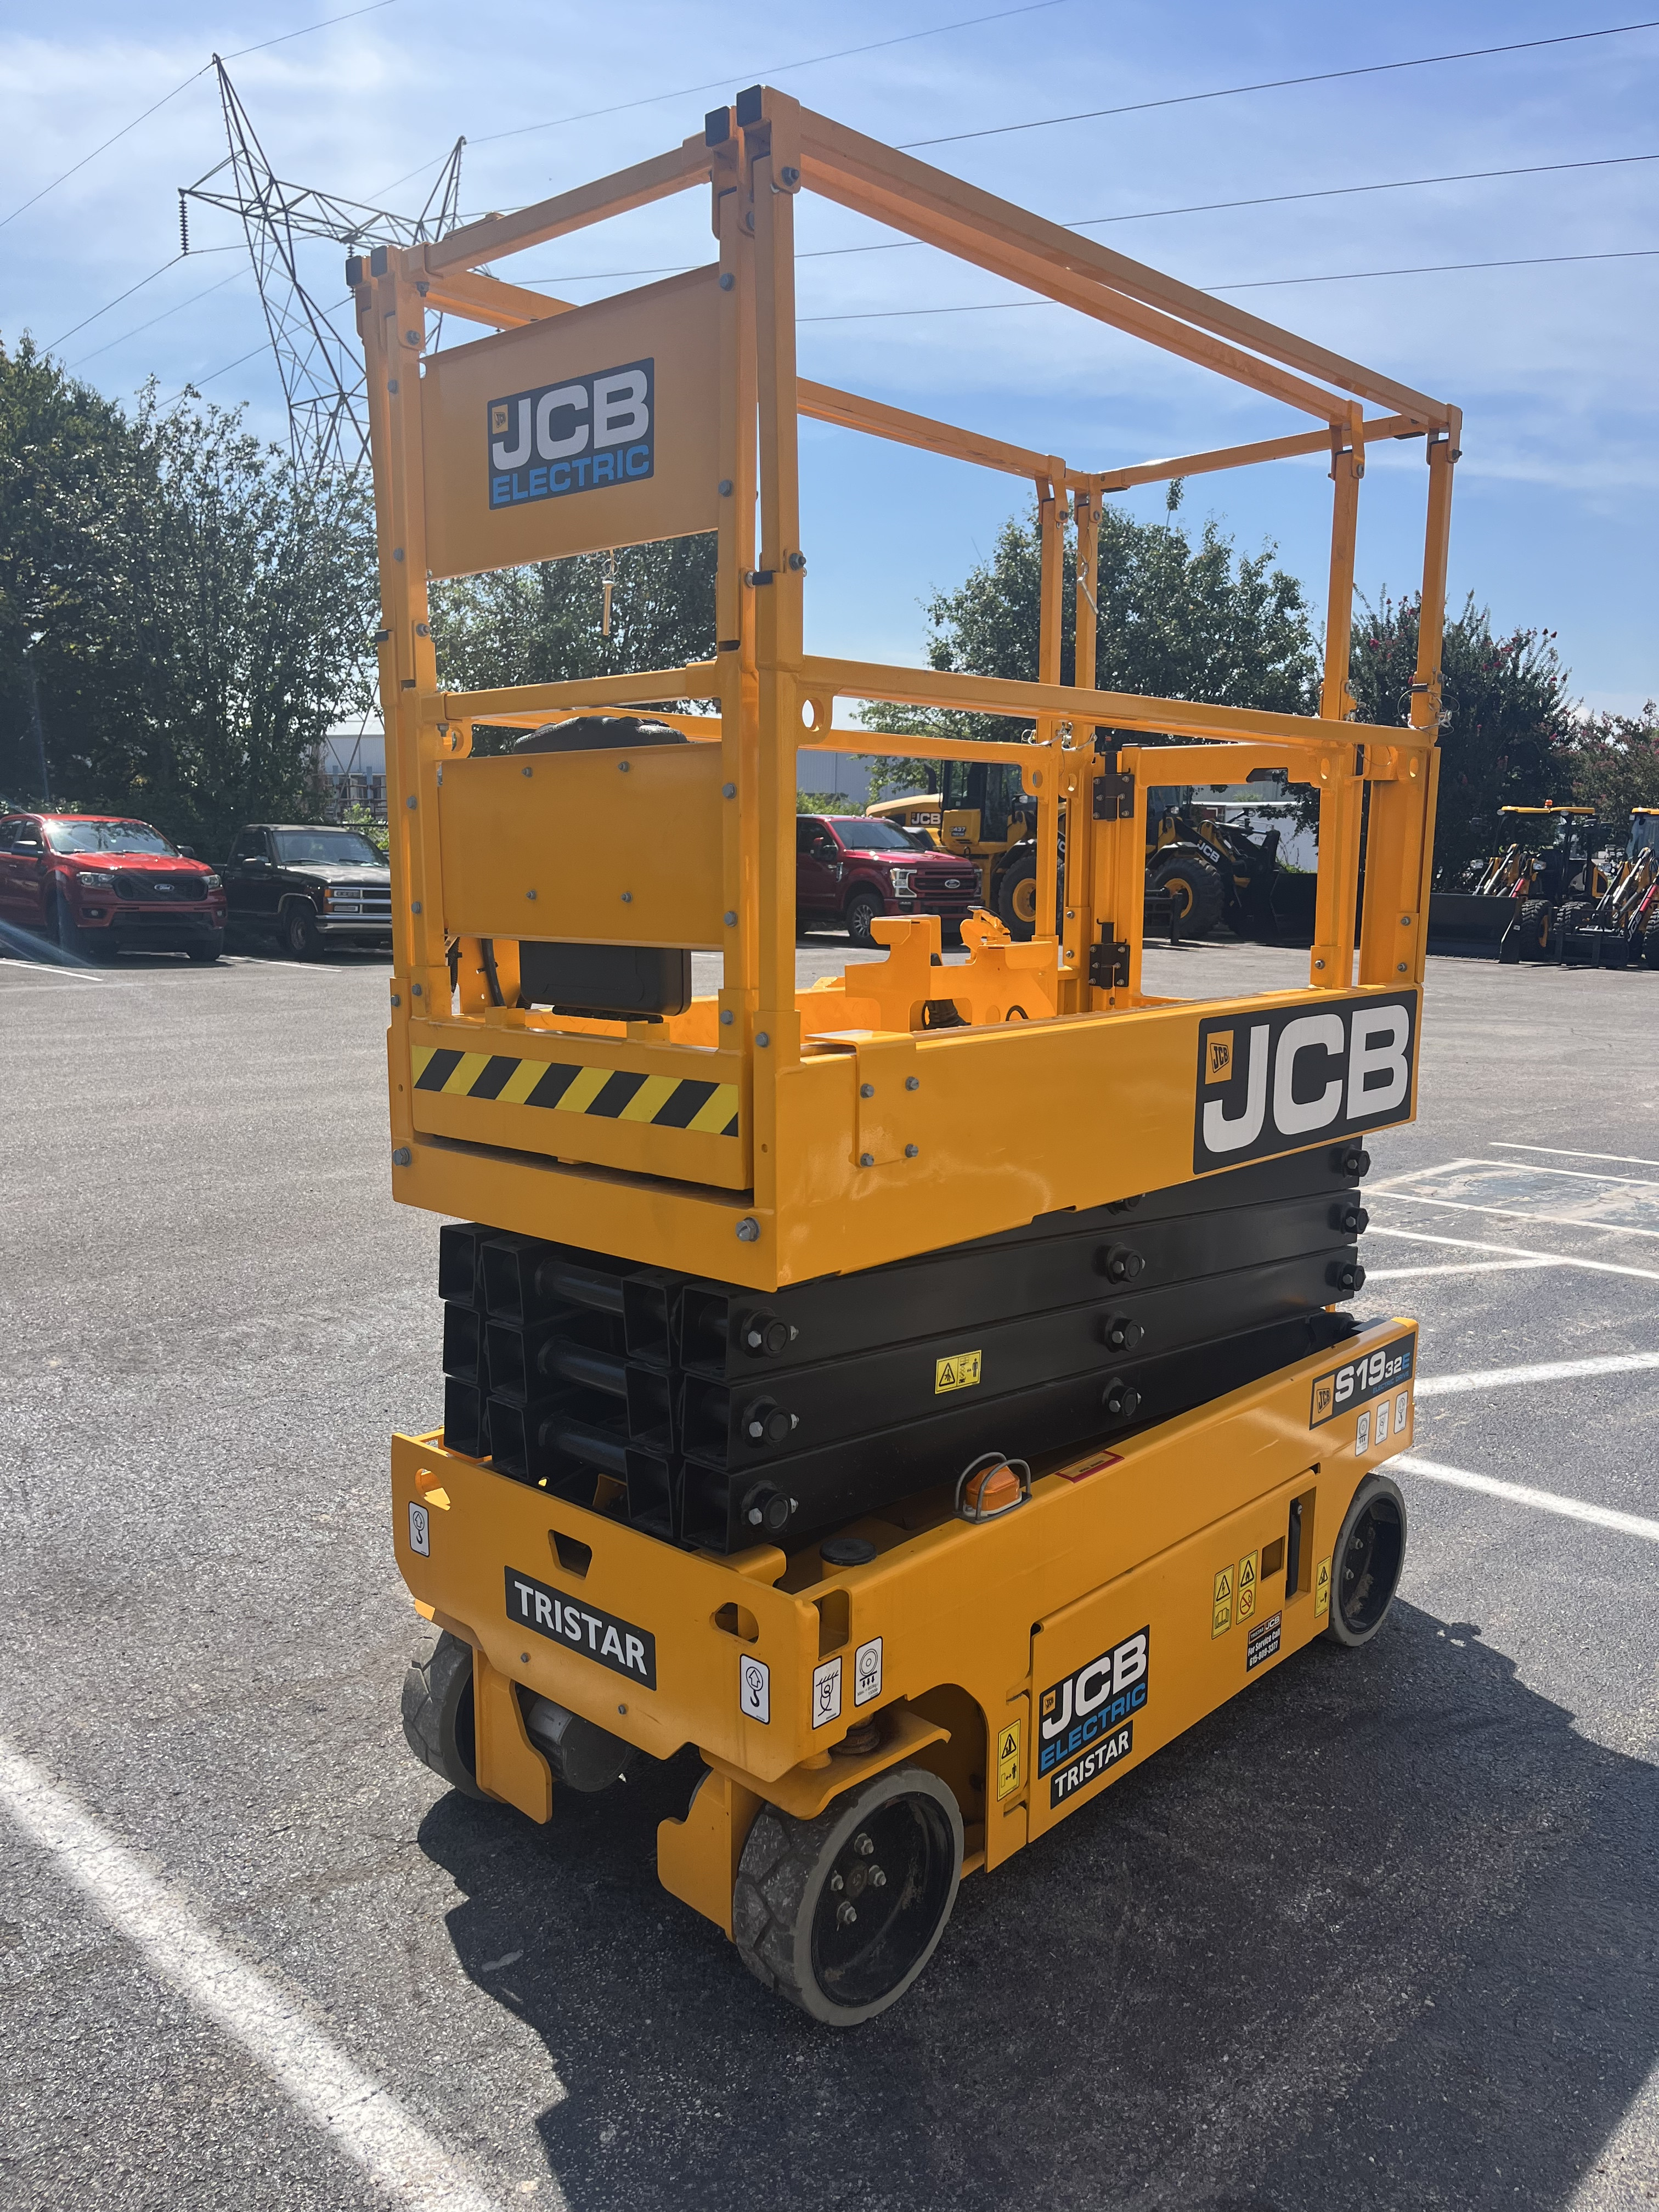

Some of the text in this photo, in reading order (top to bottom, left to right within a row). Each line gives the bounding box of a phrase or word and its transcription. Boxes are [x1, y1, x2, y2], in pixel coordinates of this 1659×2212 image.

[493, 370, 649, 470] JCB
[493, 445, 650, 504] ELECTRIC
[911, 813, 941, 824] JCB
[1197, 843, 1220, 862] JCB
[1213, 1046, 1228, 1069] JCB
[1203, 1005, 1409, 1153] JCB
[1318, 1390, 1330, 1410] JCB
[1373, 1371, 1409, 1393] ELECTRIC DRIVE
[514, 1581, 647, 1675] TRISTAR
[1255, 1635, 1272, 1651] Service
[1272, 1628, 1281, 1640] Call
[1265, 1616, 1280, 1630] JCB
[1042, 1634, 1147, 1739] JCB
[1041, 1683, 1146, 1771] ELECTRIC
[1054, 1730, 1128, 1797] TRISTAR
